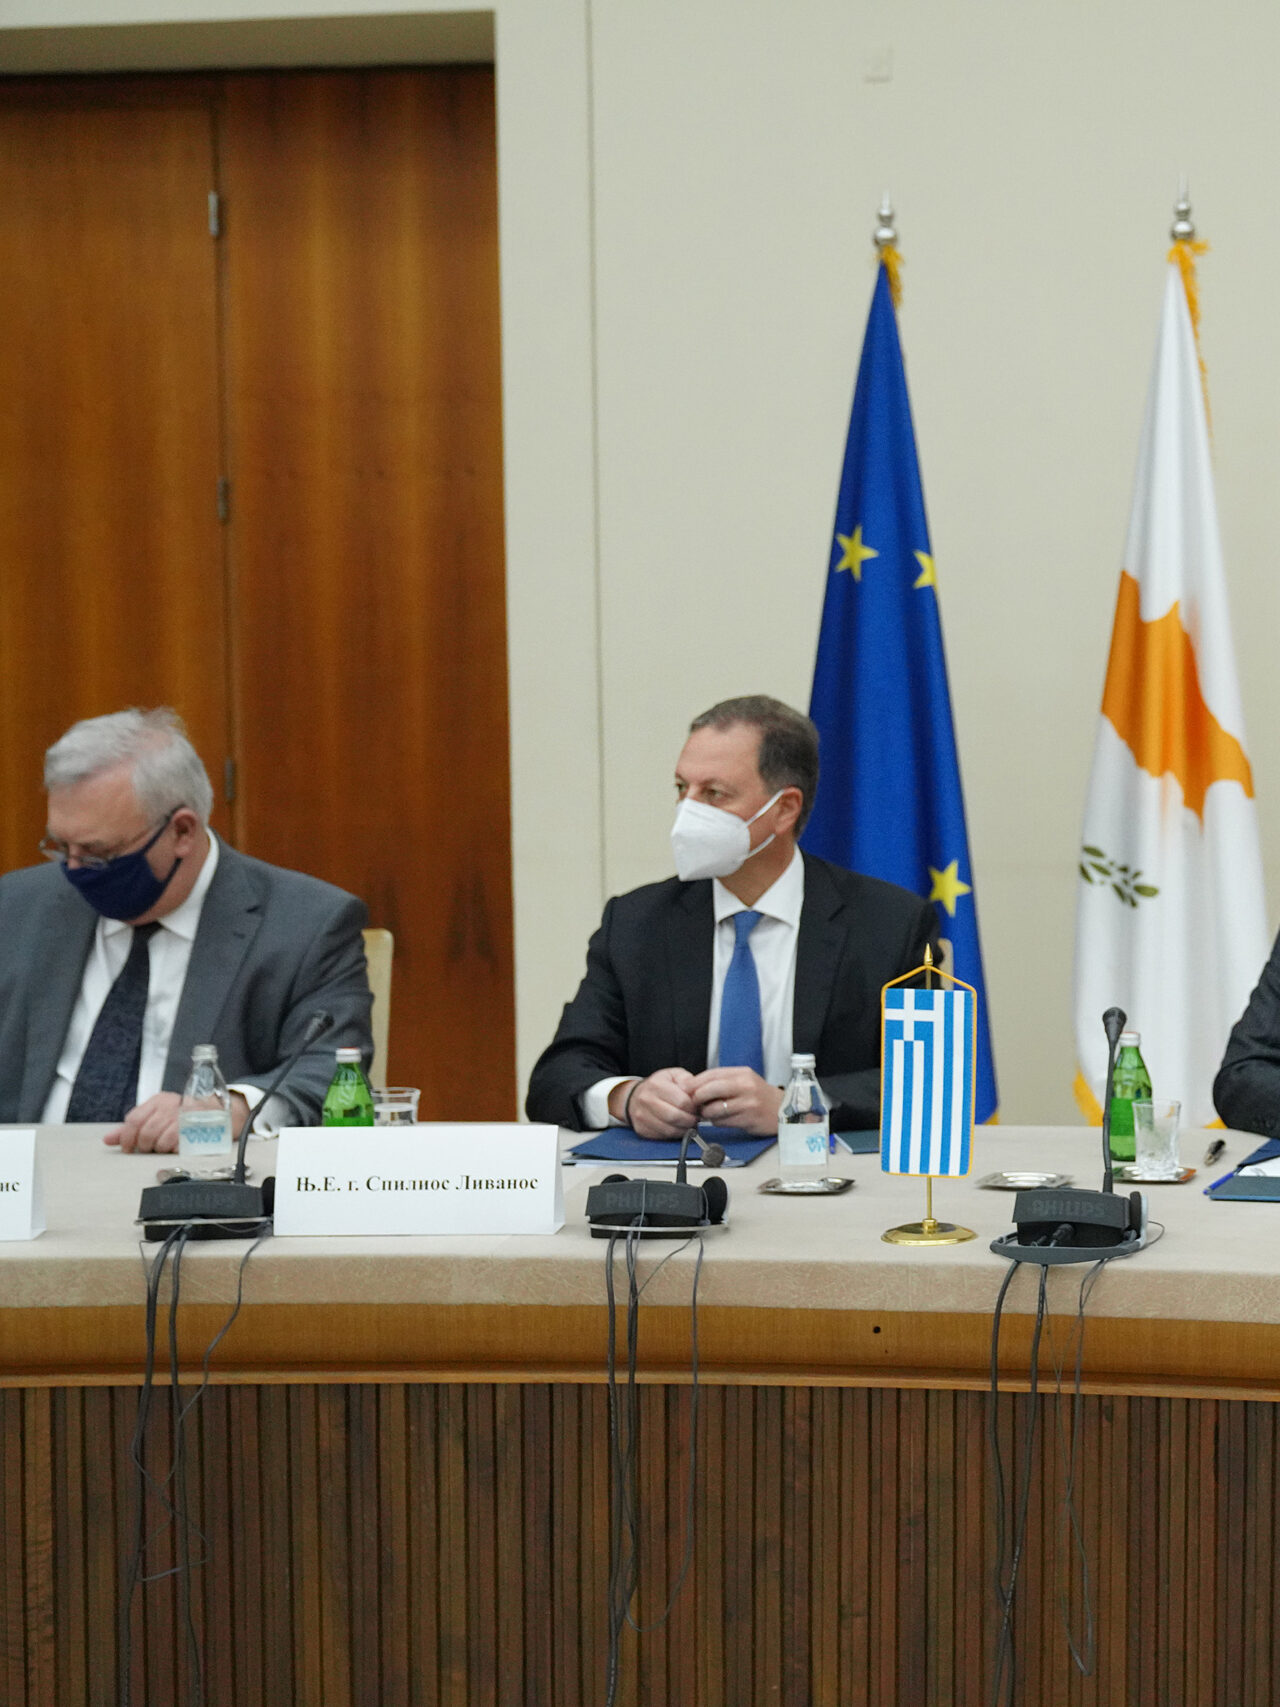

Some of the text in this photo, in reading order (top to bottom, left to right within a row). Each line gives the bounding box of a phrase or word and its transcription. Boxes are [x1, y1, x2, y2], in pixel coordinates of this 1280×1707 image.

[296, 1175, 539, 1192] Њ.Е. г. Спилиос Ливанос
[1031, 1198, 1106, 1217] PHILIPS
